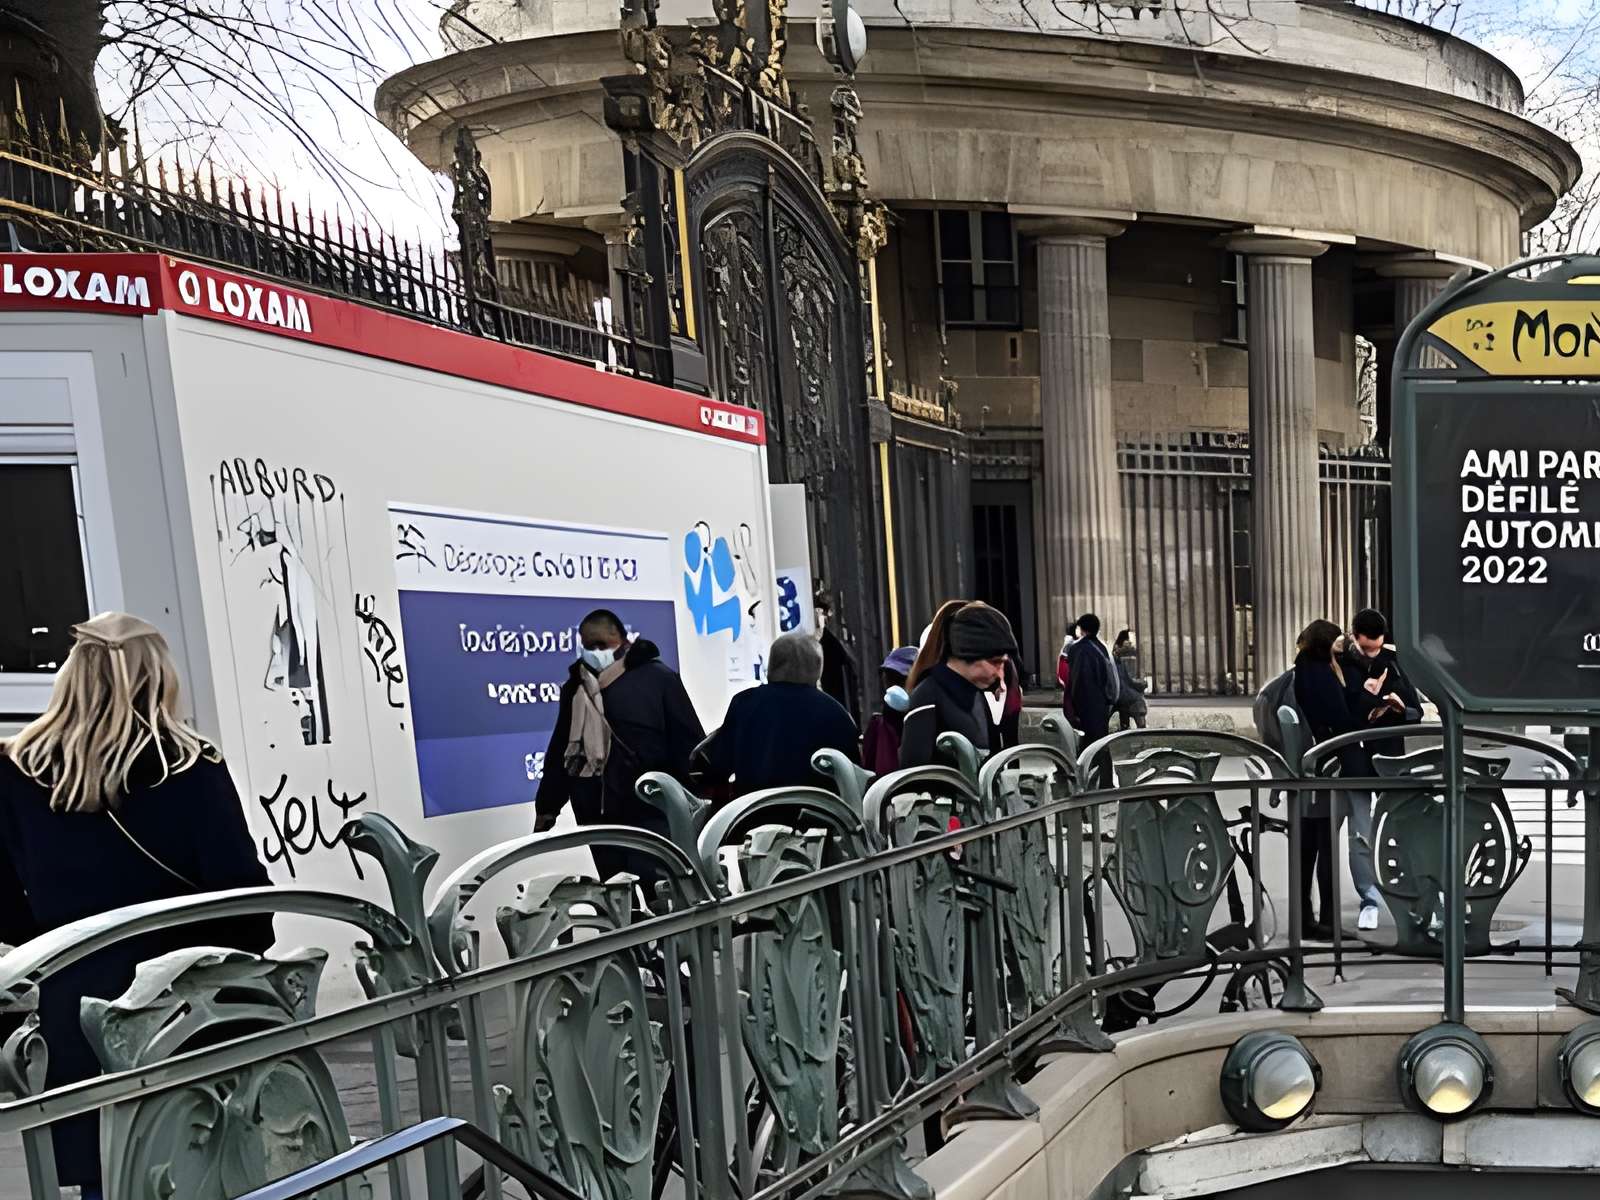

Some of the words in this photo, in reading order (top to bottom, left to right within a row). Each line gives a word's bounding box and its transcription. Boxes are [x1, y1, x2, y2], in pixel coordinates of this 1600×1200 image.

[3, 263, 151, 308] LOXAM
[206, 275, 312, 334] LOXAM
[1460, 449, 1529, 480] AMI
[1461, 479, 1581, 514] DÉFILÉ
[1461, 555, 1549, 584] 2022
